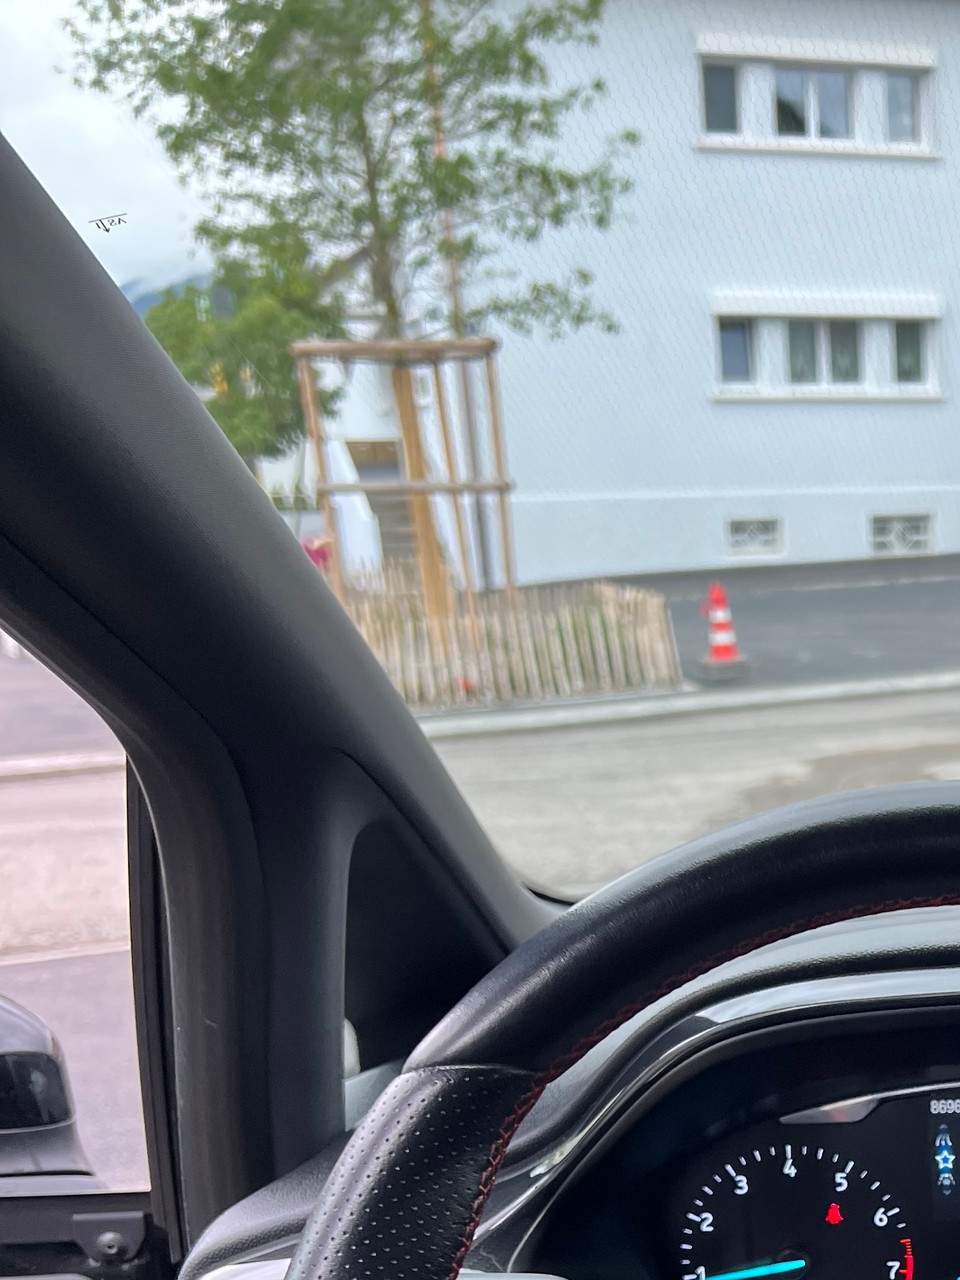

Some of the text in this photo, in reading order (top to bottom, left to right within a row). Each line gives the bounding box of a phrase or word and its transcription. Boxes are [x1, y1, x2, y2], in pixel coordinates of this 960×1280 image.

[782, 1158, 797, 1178] 4
[733, 1174, 749, 1195] 3
[834, 1171, 848, 1192] 5
[700, 1212, 714, 1232] 2
[873, 1207, 889, 1227] 6
[886, 1261, 900, 1280] 7
